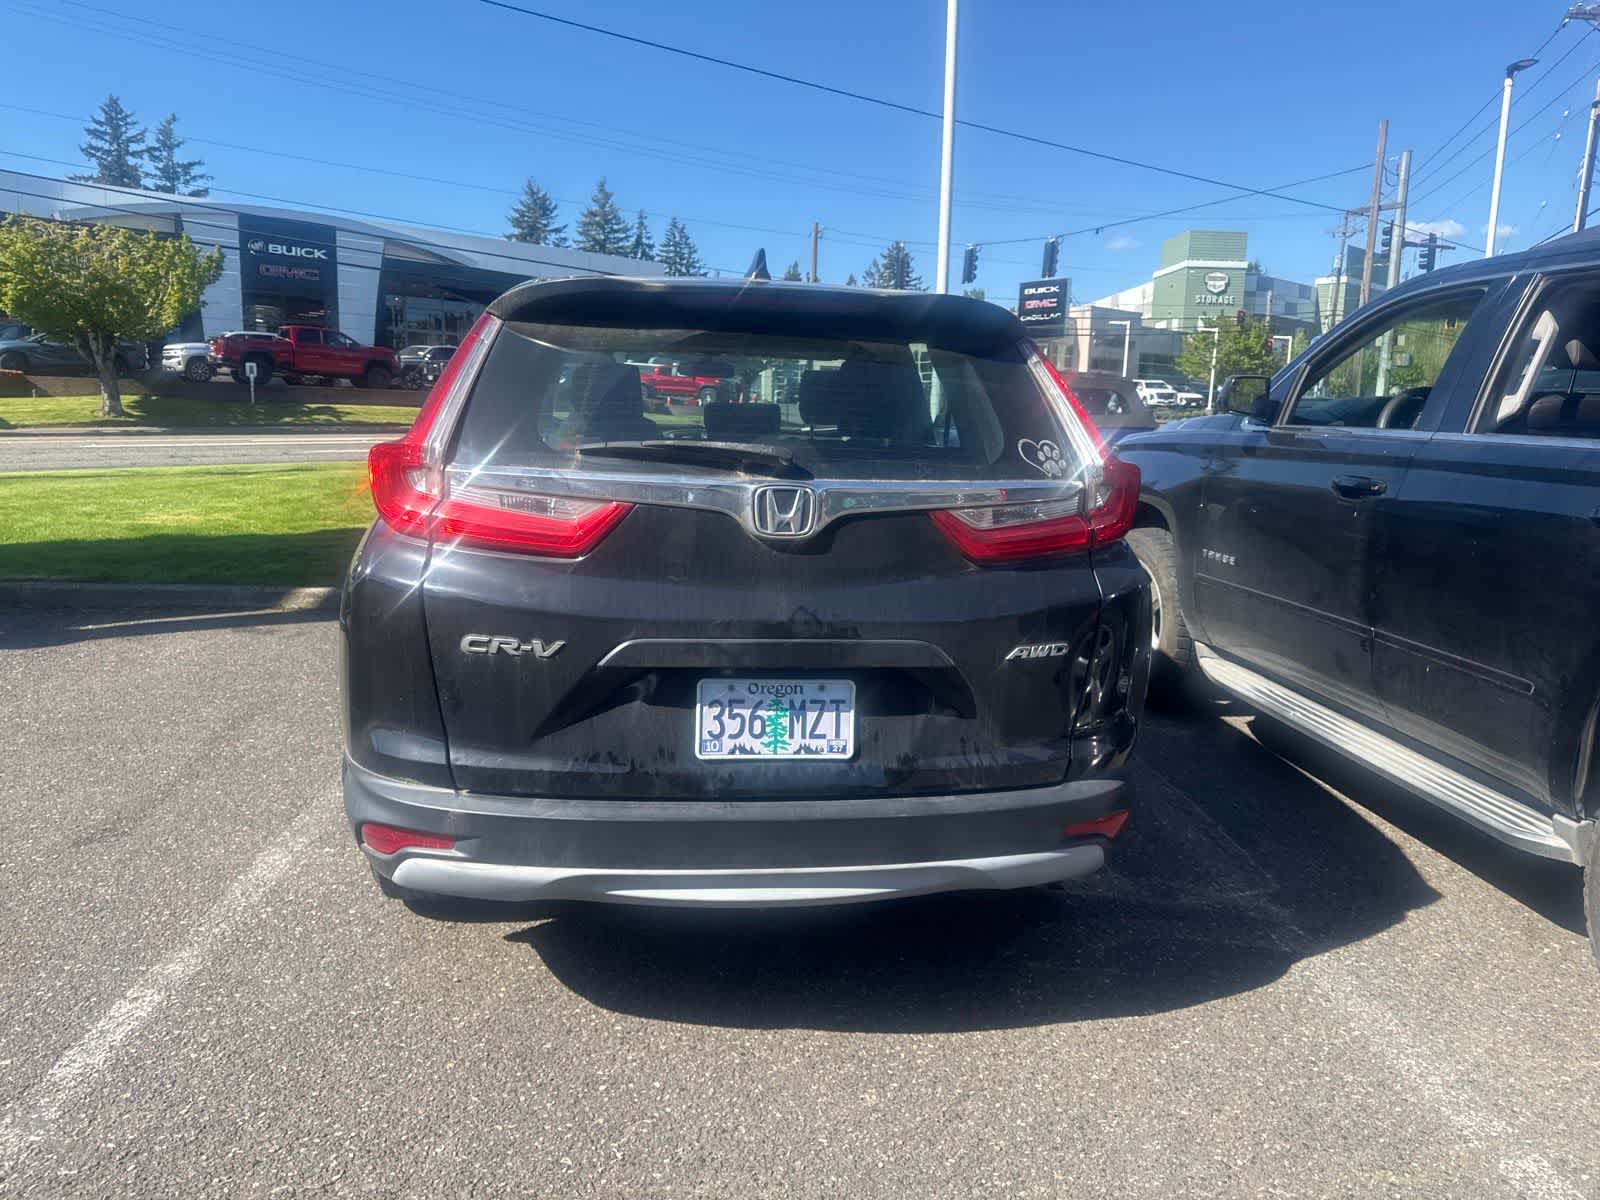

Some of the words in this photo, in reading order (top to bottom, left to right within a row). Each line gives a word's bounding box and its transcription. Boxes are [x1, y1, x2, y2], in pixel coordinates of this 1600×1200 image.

[268, 243, 328, 260] BUICK
[1024, 285, 1060, 295] BUICK
[1024, 298, 1057, 309] GMC
[1195, 295, 1235, 305] STORAGE
[460, 633, 566, 660] CR-V
[1005, 643, 1069, 660] AWD
[748, 682, 804, 698] Oregon
[707, 699, 766, 740] 356
[789, 699, 846, 740] MZT
[704, 741, 719, 751] 10
